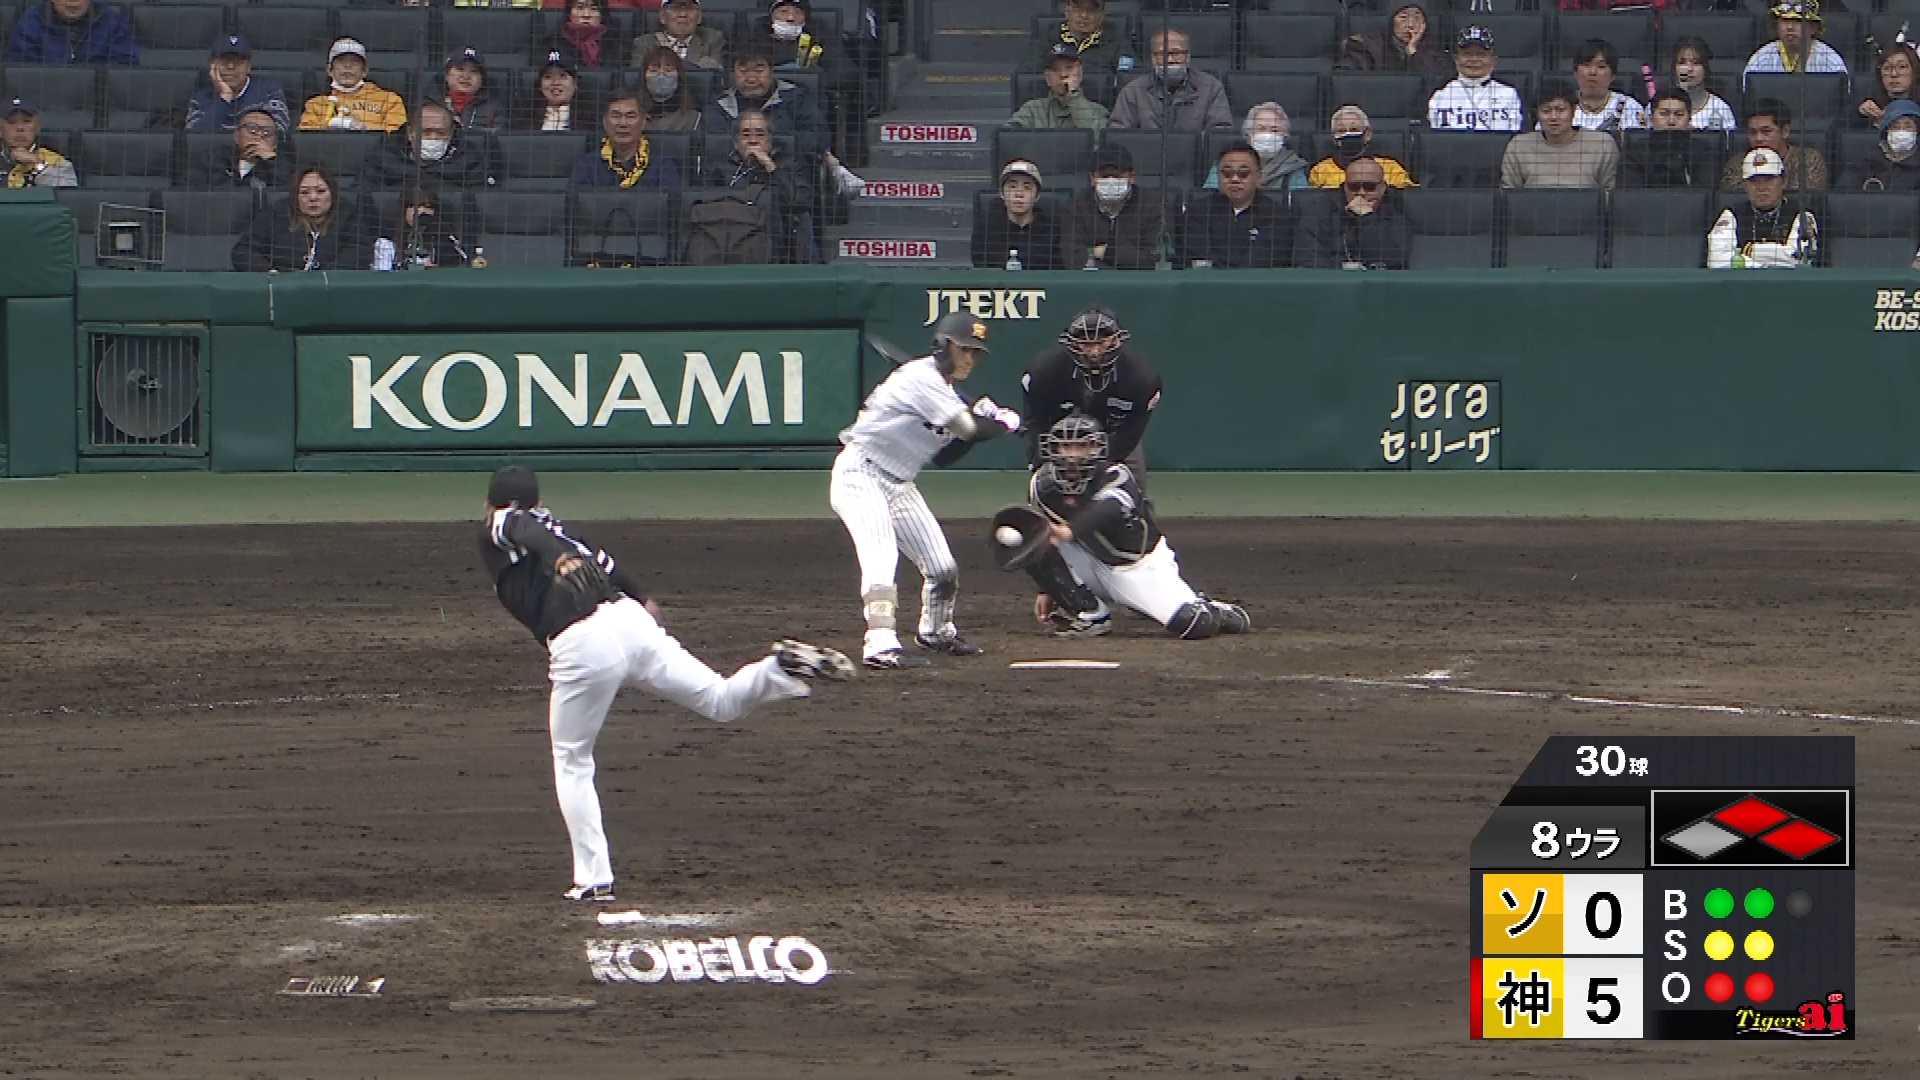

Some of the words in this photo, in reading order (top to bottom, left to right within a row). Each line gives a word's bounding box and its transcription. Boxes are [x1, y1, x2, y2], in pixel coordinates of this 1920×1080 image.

[1437, 106, 1510, 129] Tigers
[885, 126, 972, 141] TOSHIBA
[864, 183, 941, 197] TOSHIBA
[843, 241, 931, 257] TOSHIBA
[923, 288, 1046, 326] JTEKT
[1874, 311, 1920, 331] KOS
[348, 351, 804, 431] KONAMI
[584, 935, 828, 985] KOBELCO
